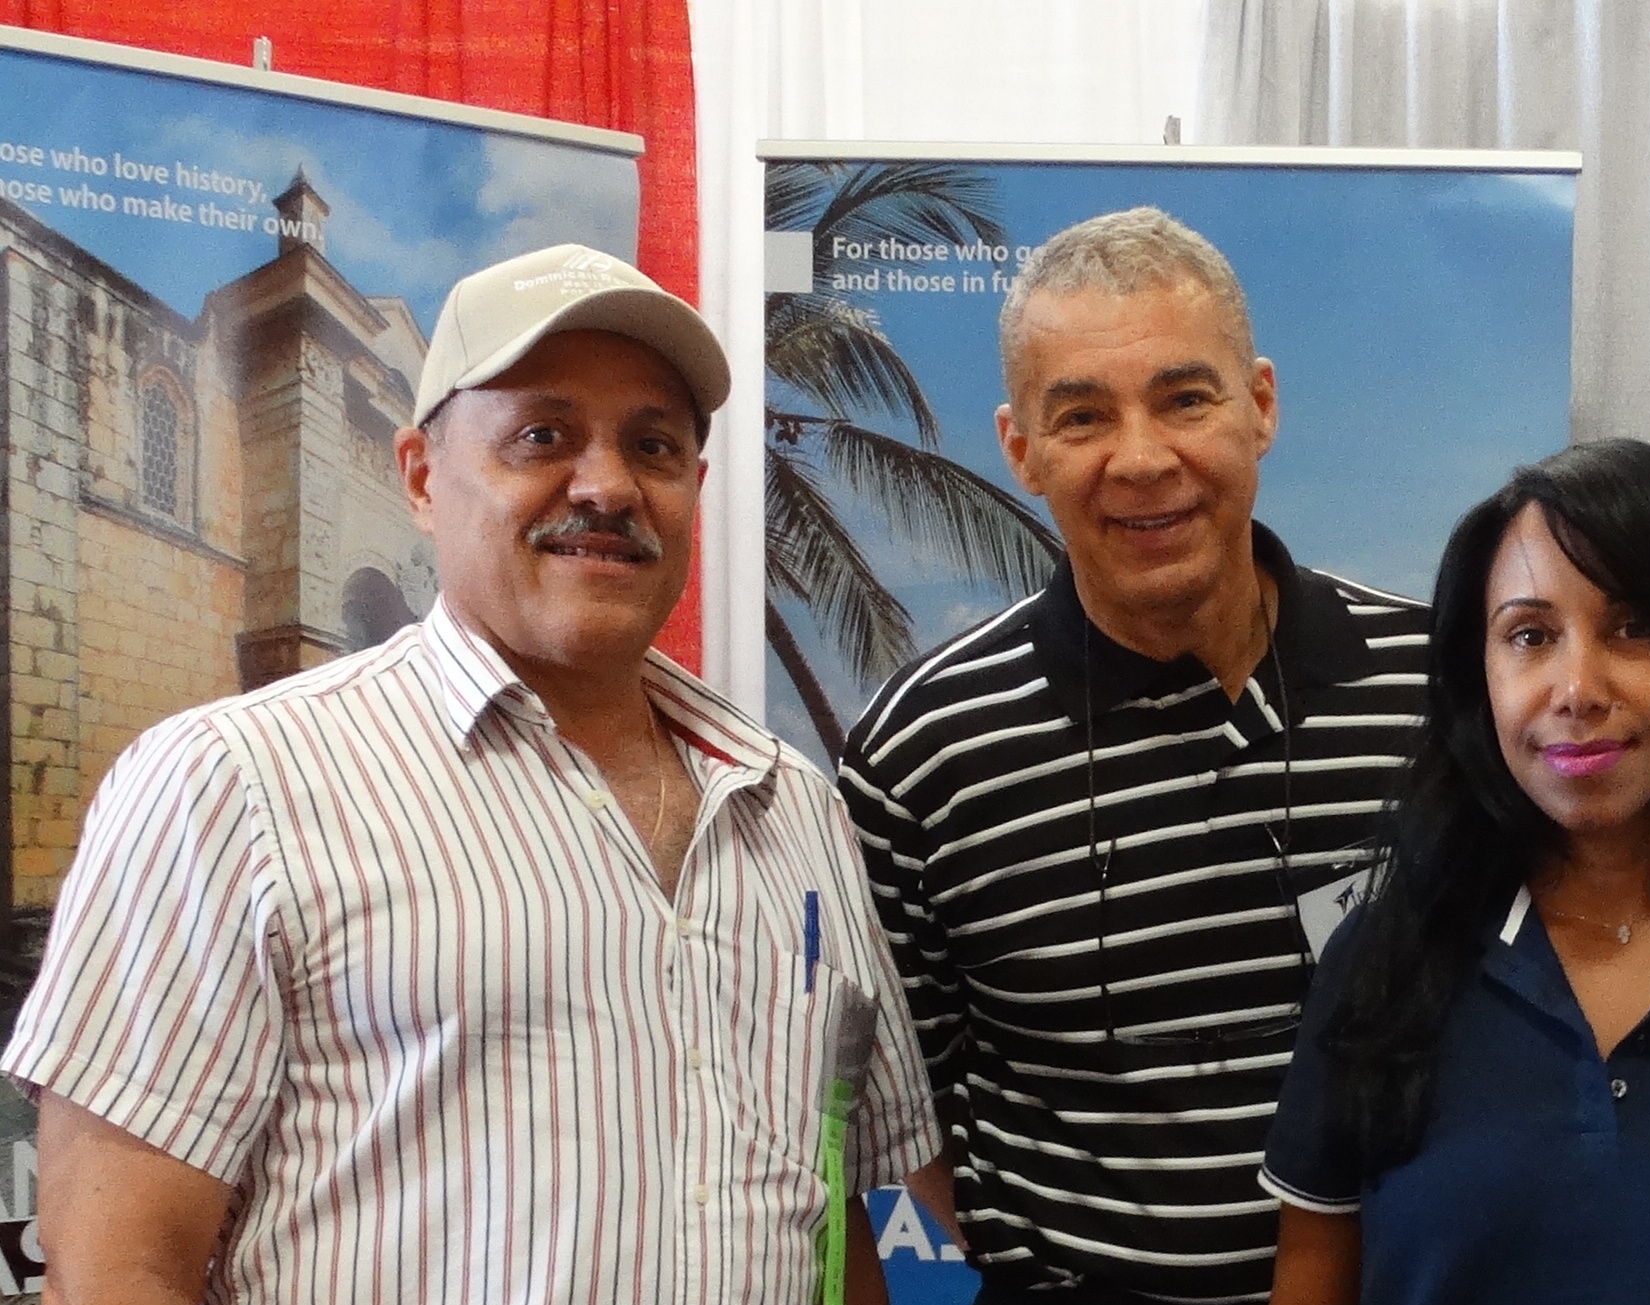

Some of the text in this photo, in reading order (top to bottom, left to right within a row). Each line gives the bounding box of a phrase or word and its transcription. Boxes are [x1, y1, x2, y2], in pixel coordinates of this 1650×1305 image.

[51, 146, 108, 176] who
[114, 152, 169, 184] love
[176, 160, 267, 204] history,
[58, 183, 116, 212] who
[123, 195, 193, 224] make
[199, 202, 258, 232] their
[262, 214, 325, 242] own.
[832, 236, 1009, 262] For those who
[832, 268, 879, 292] and
[886, 270, 955, 293] those
[962, 270, 985, 293] in
